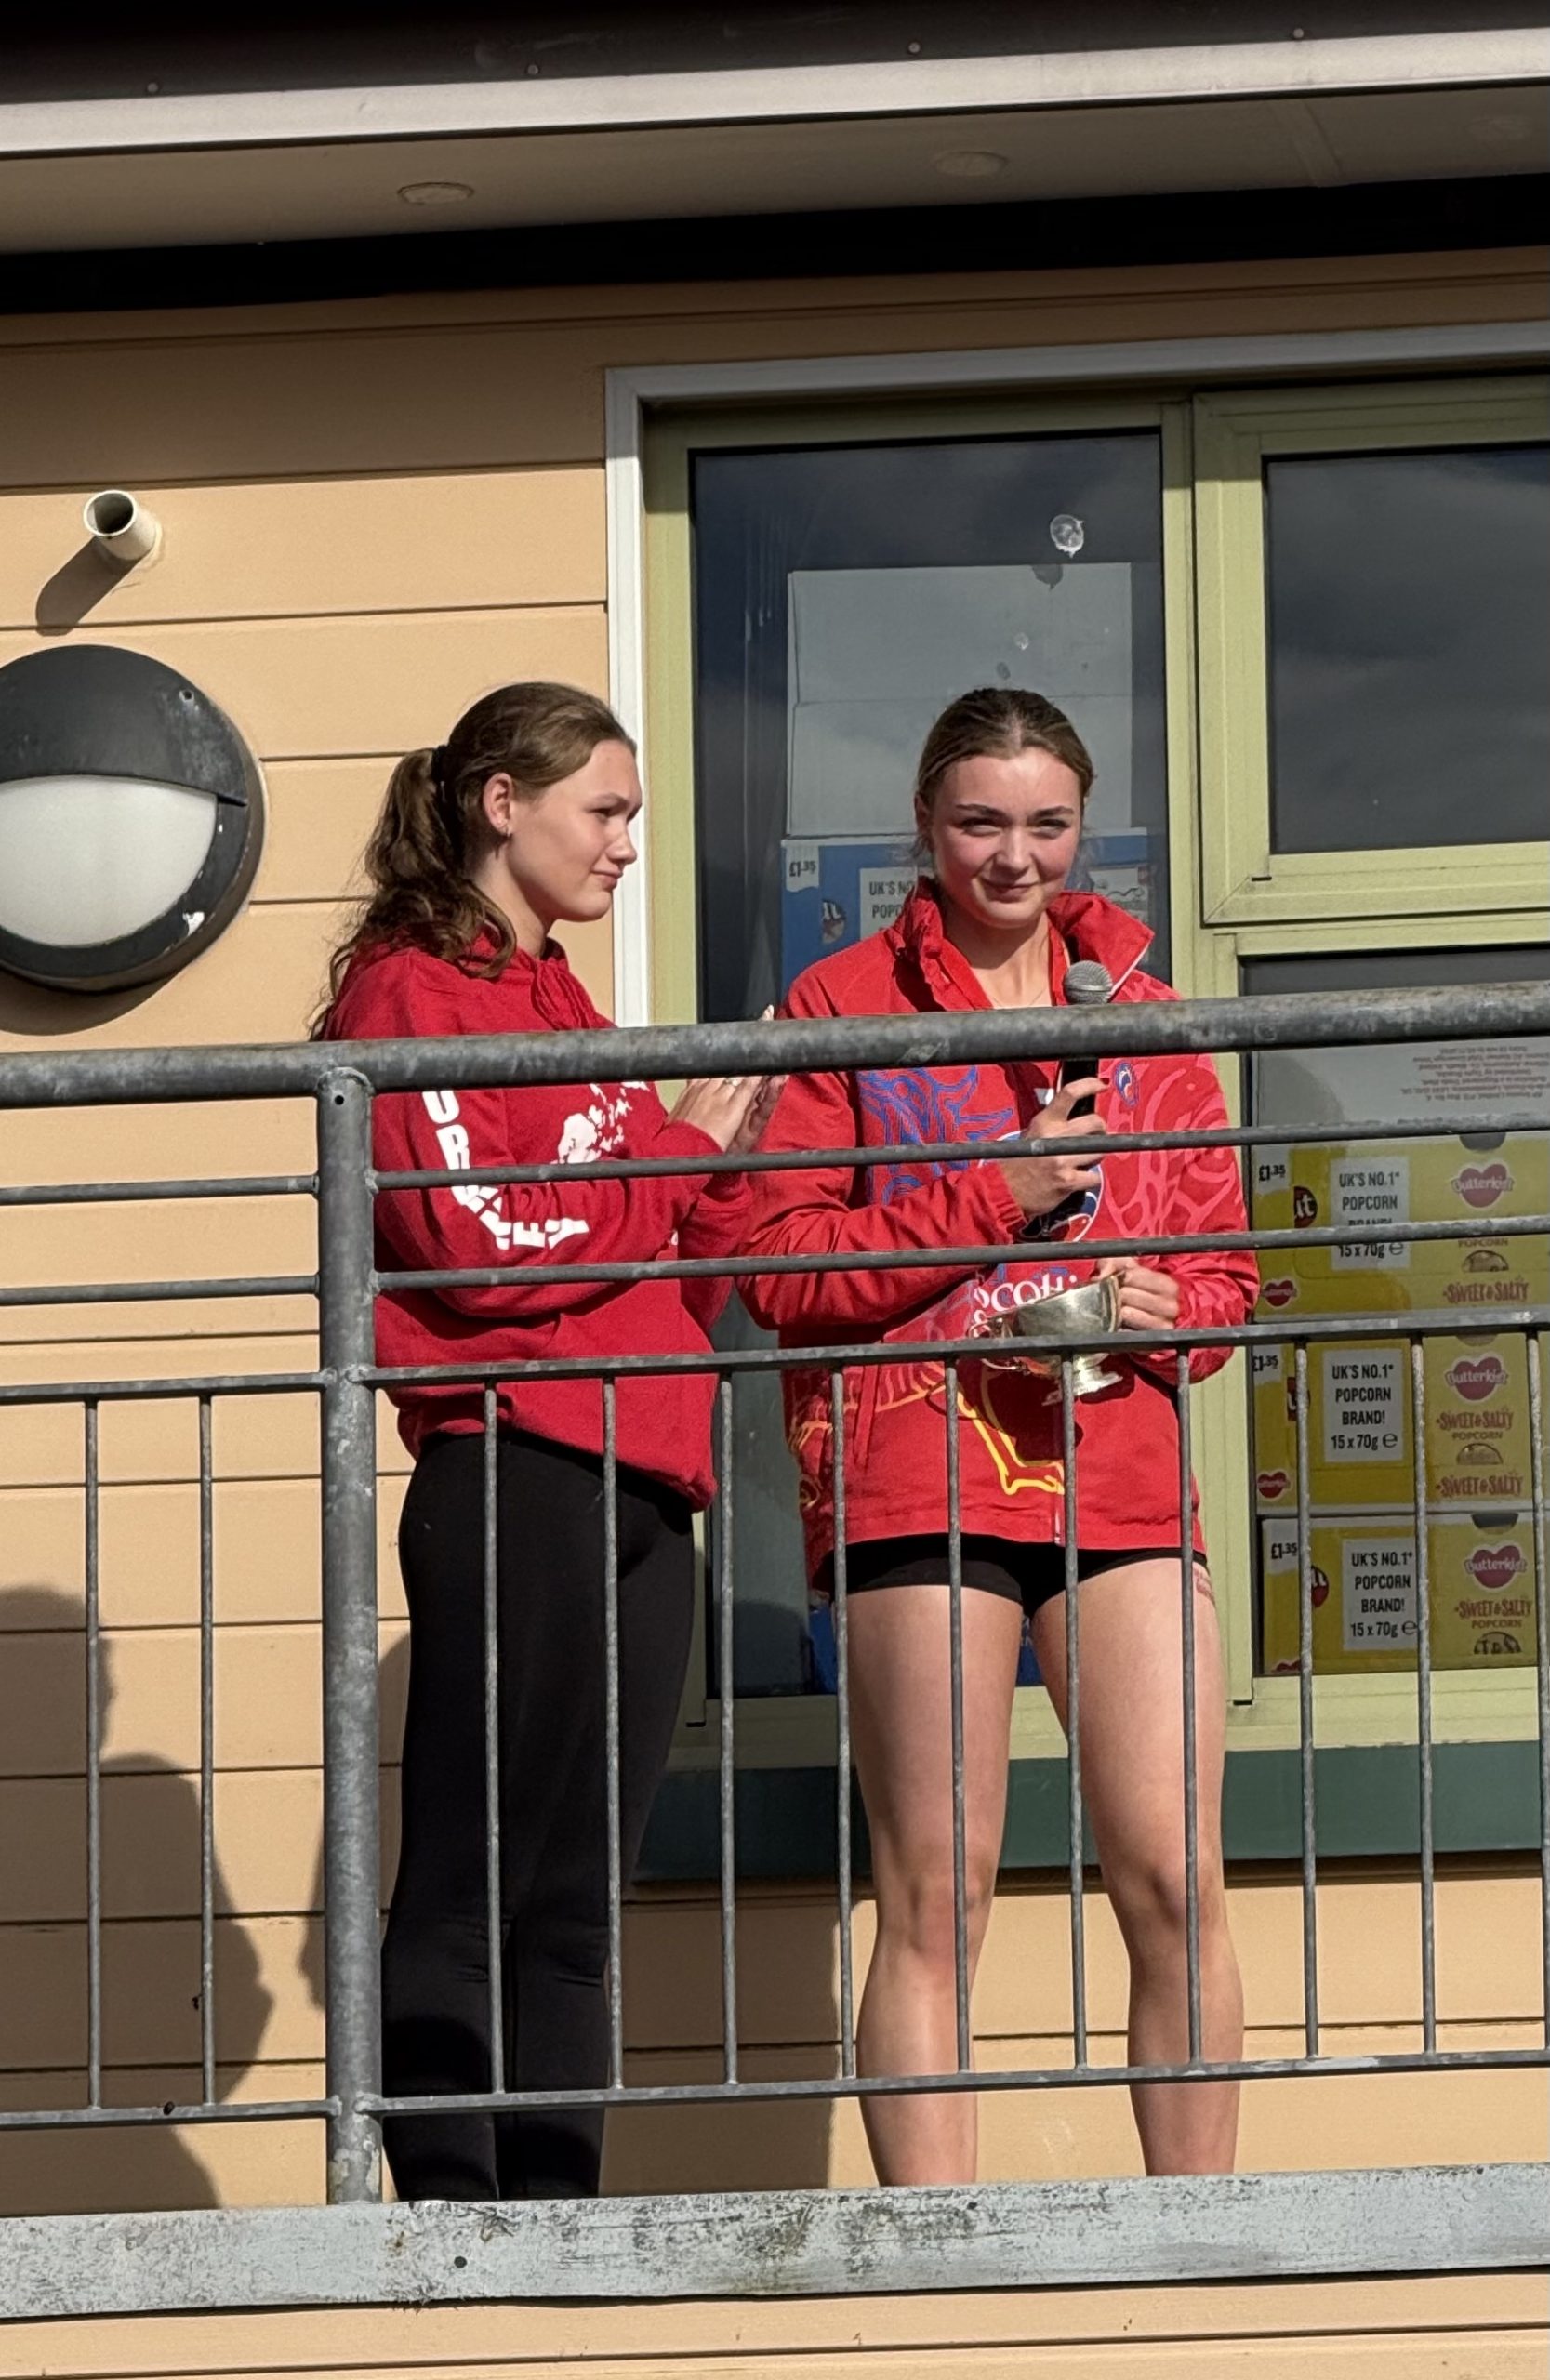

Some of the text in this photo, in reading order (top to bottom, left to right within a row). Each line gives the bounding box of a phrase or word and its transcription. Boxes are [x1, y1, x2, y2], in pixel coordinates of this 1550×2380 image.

[869, 881, 895, 895] UK'S
[1259, 1165, 1285, 1182] £1.35
[1339, 1172, 1365, 1187] UK'S
[1343, 1195, 1398, 1210] POPCORN
[1458, 1238, 1508, 1248] POPCORN
[1339, 1244, 1353, 1258] 15
[1355, 1246, 1361, 1257] x
[1363, 1243, 1384, 1259] 70g
[1447, 1282, 1485, 1303] SWEET
[1494, 1281, 1529, 1302] SALTY
[1331, 1365, 1358, 1380] UK'S
[1335, 1387, 1391, 1403] POPCORN
[1342, 1411, 1385, 1425] BRAND!
[1439, 1412, 1474, 1430] SWEET
[1483, 1411, 1514, 1430] SALTY
[1331, 1435, 1345, 1449] 15
[1347, 1438, 1355, 1448] x
[1357, 1434, 1378, 1450] 70g
[1452, 1431, 1504, 1440] POPCORN
[1441, 1476, 1479, 1498] SWEET
[1489, 1475, 1524, 1496] SALTY
[1271, 1543, 1298, 1559] £1.35
[1351, 1552, 1378, 1567] UK'S
[1355, 1575, 1411, 1590] POPCORN
[1361, 1598, 1405, 1613] BRAND!
[1458, 1599, 1493, 1619] SWEET
[1502, 1598, 1532, 1617] SALTY
[1351, 1623, 1364, 1637] 15
[1367, 1625, 1373, 1636] x
[1376, 1622, 1398, 1638] 70g
[1472, 1620, 1522, 1629] POPCORN
